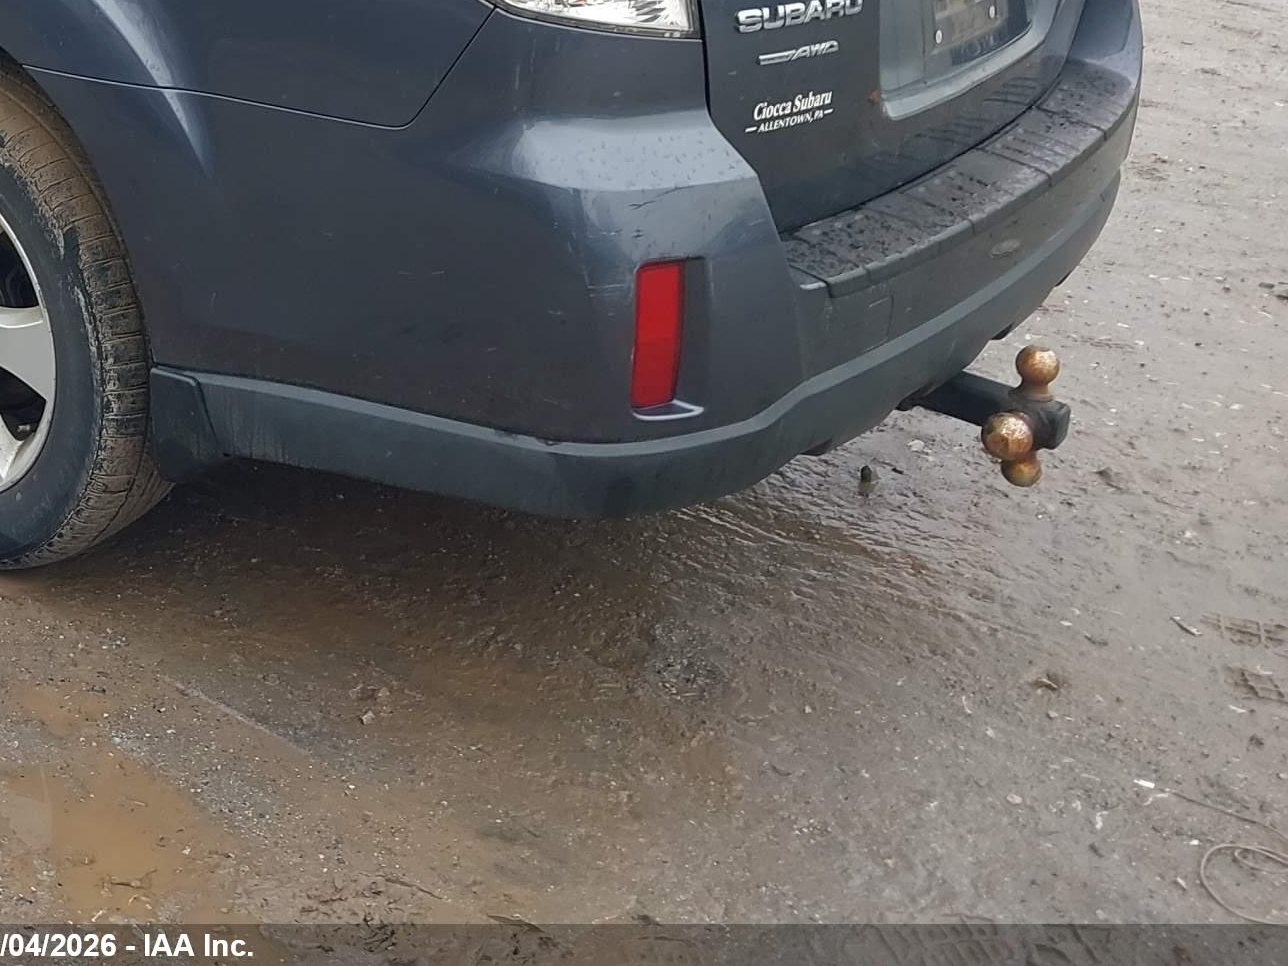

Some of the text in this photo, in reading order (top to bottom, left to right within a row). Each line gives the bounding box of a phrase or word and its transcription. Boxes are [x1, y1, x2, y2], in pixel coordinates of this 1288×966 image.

[791, 39, 840, 61] AWD
[753, 91, 832, 121] Ciocca Subaru
